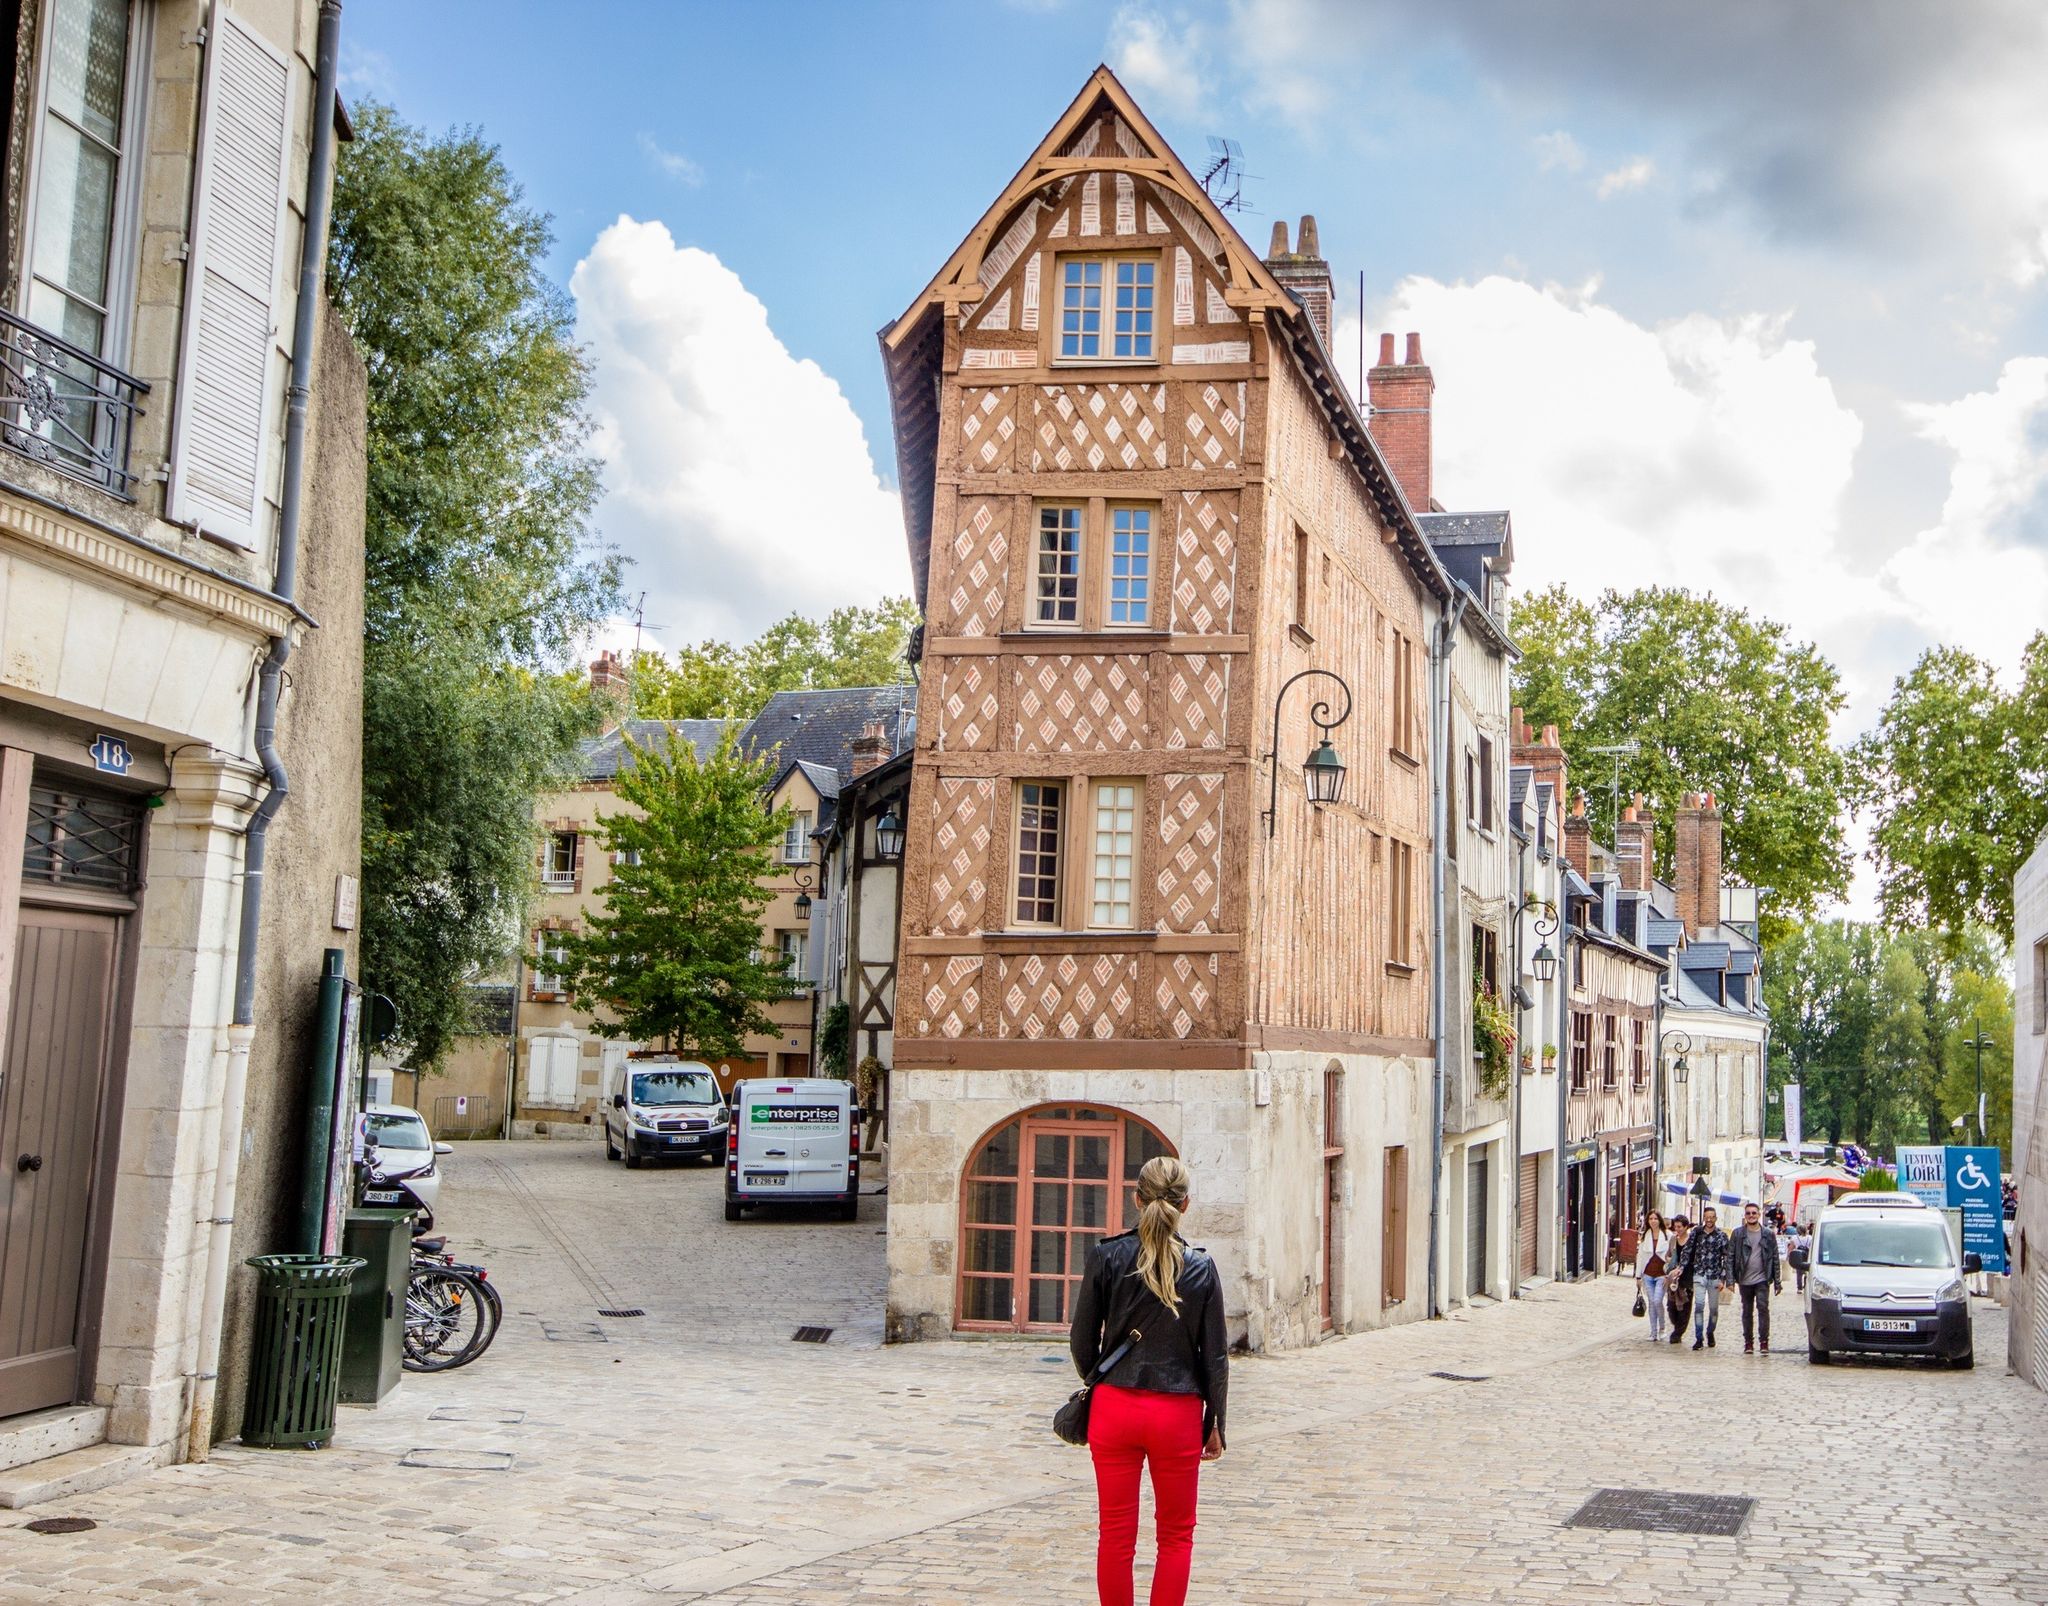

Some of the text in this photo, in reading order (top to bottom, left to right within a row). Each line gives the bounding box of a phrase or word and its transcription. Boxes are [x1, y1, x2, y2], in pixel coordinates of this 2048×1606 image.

[102, 741, 124, 768] 18
[753, 1107, 838, 1121] enterprise
[1905, 1154, 1945, 1165] FESTIVAL
